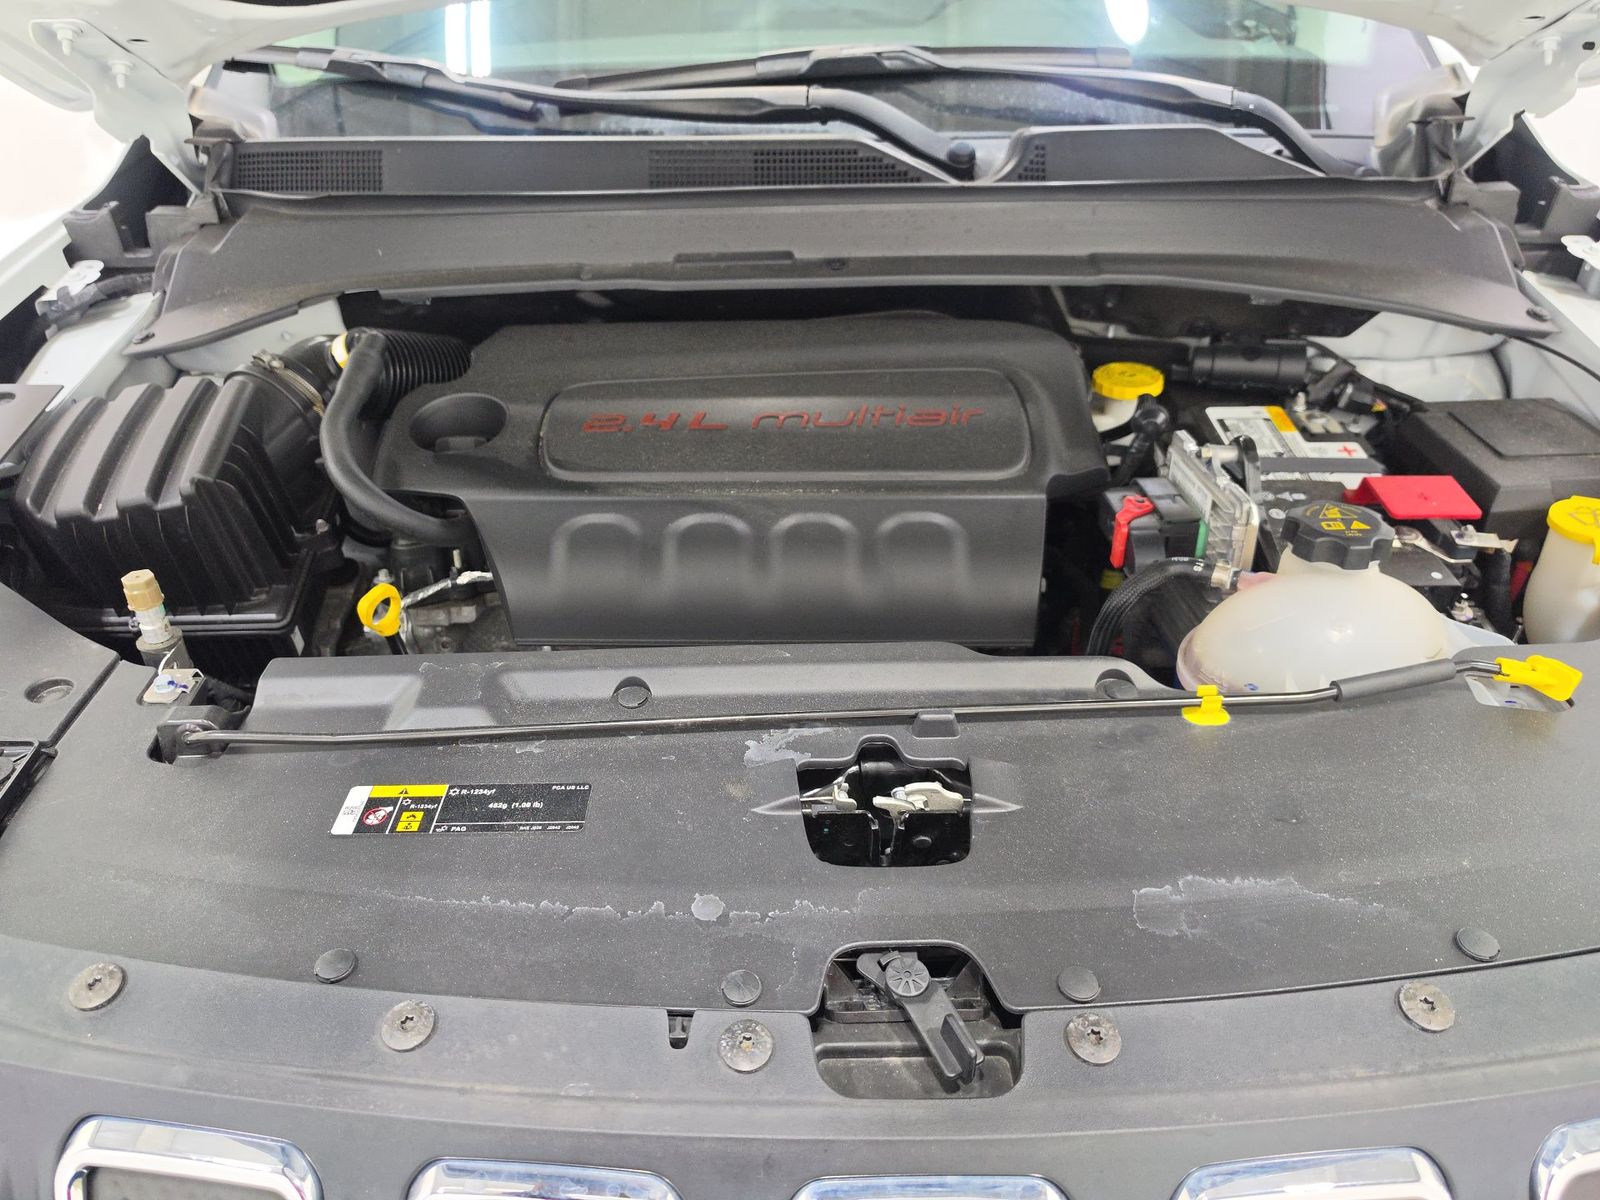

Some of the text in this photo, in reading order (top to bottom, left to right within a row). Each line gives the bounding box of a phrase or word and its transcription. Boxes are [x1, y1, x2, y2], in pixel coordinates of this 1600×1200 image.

[582, 403, 985, 432] 2.4L multiair
[460, 788, 496, 796] R-1234yf
